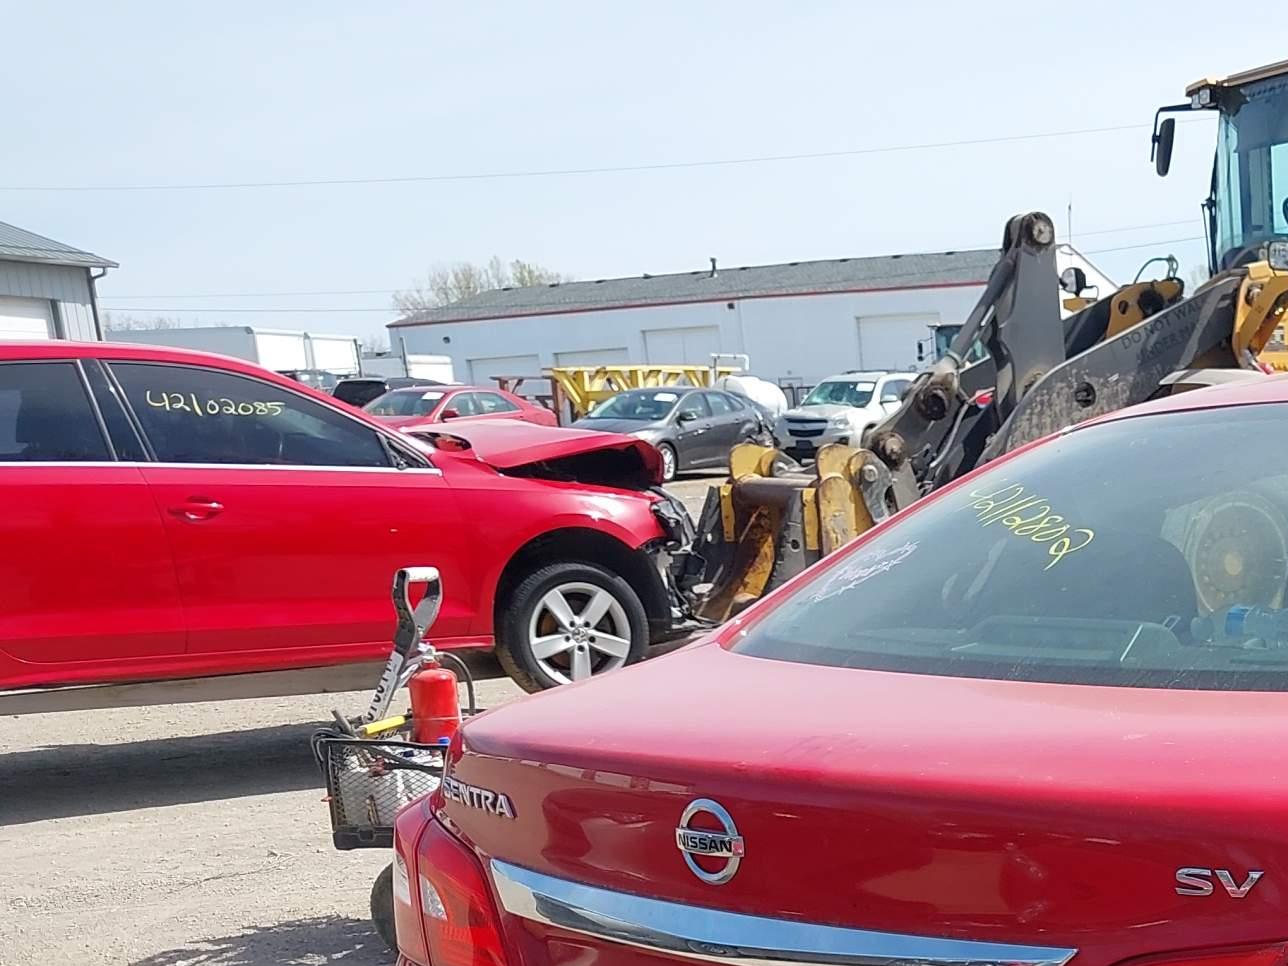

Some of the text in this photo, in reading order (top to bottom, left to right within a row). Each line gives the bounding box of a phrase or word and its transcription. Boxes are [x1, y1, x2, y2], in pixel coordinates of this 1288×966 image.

[1121, 333, 1142, 350] DO
[1143, 314, 1170, 337] NOT
[146, 390, 286, 416] 42102085
[443, 776, 517, 819] SENTRA
[678, 832, 733, 853] NISSAN
[1175, 867, 1264, 898] SV
